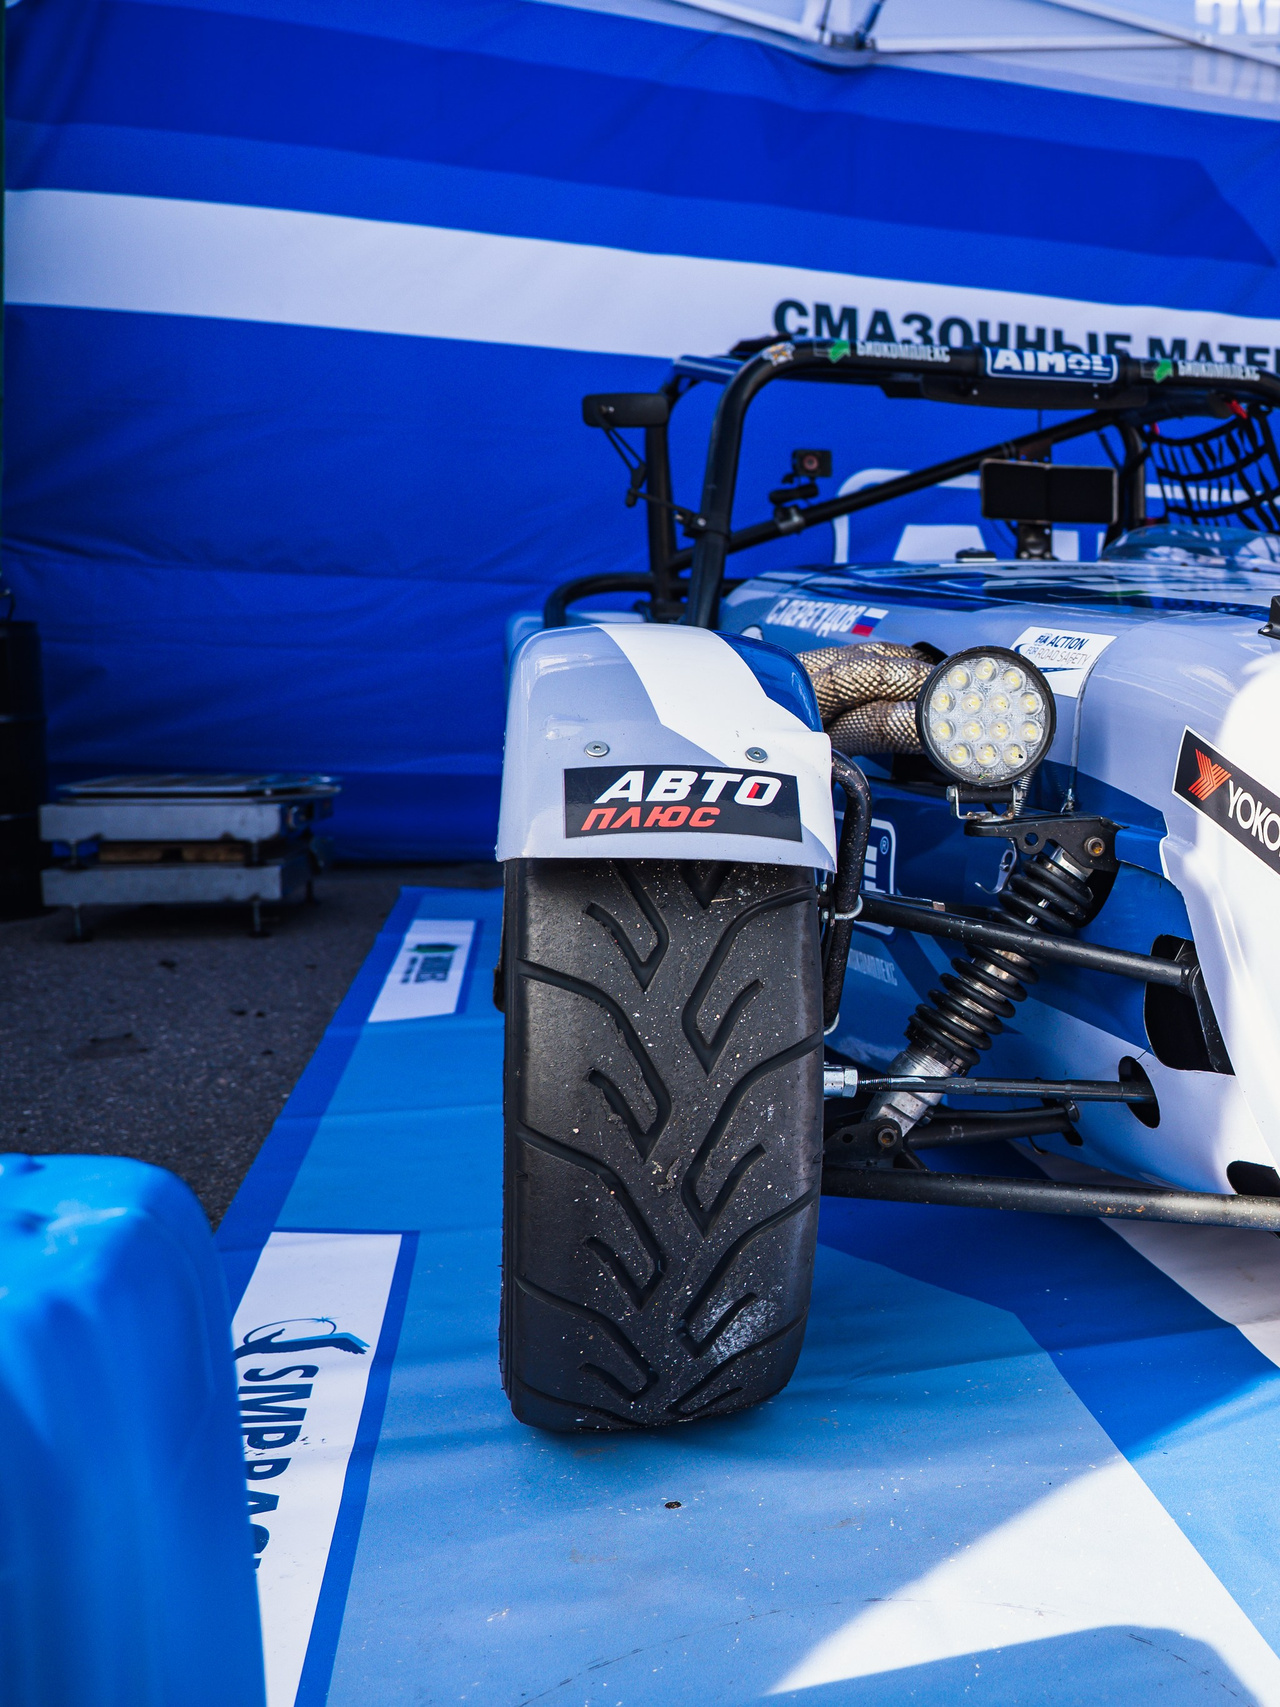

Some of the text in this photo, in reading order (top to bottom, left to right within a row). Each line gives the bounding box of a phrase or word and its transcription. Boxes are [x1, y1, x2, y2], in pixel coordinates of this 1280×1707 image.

[773, 299, 1132, 353] СМАЗОЧНЫЕ
[1046, 634, 1090, 651] ACTION
[1034, 647, 1060, 661] ROAD
[1056, 649, 1092, 666] SAFETY
[594, 770, 782, 807] АВТО
[581, 805, 721, 831] ПЛЮС
